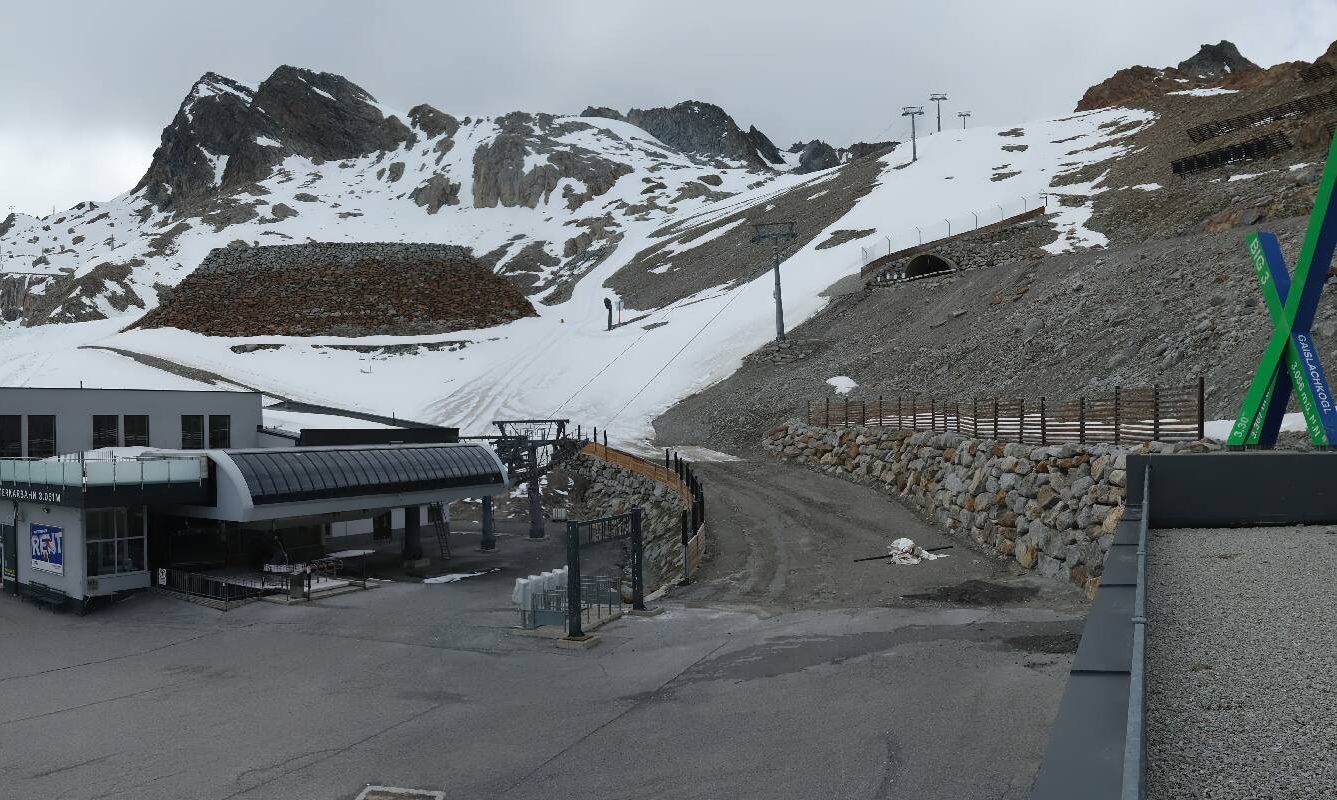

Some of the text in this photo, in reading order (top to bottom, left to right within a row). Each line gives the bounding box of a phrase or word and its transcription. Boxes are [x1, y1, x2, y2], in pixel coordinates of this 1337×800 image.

[1250, 238, 1270, 285] BIG 3
[1297, 334, 1332, 414] GAISLACHKOGL
[31, 532, 63, 556] RENT
